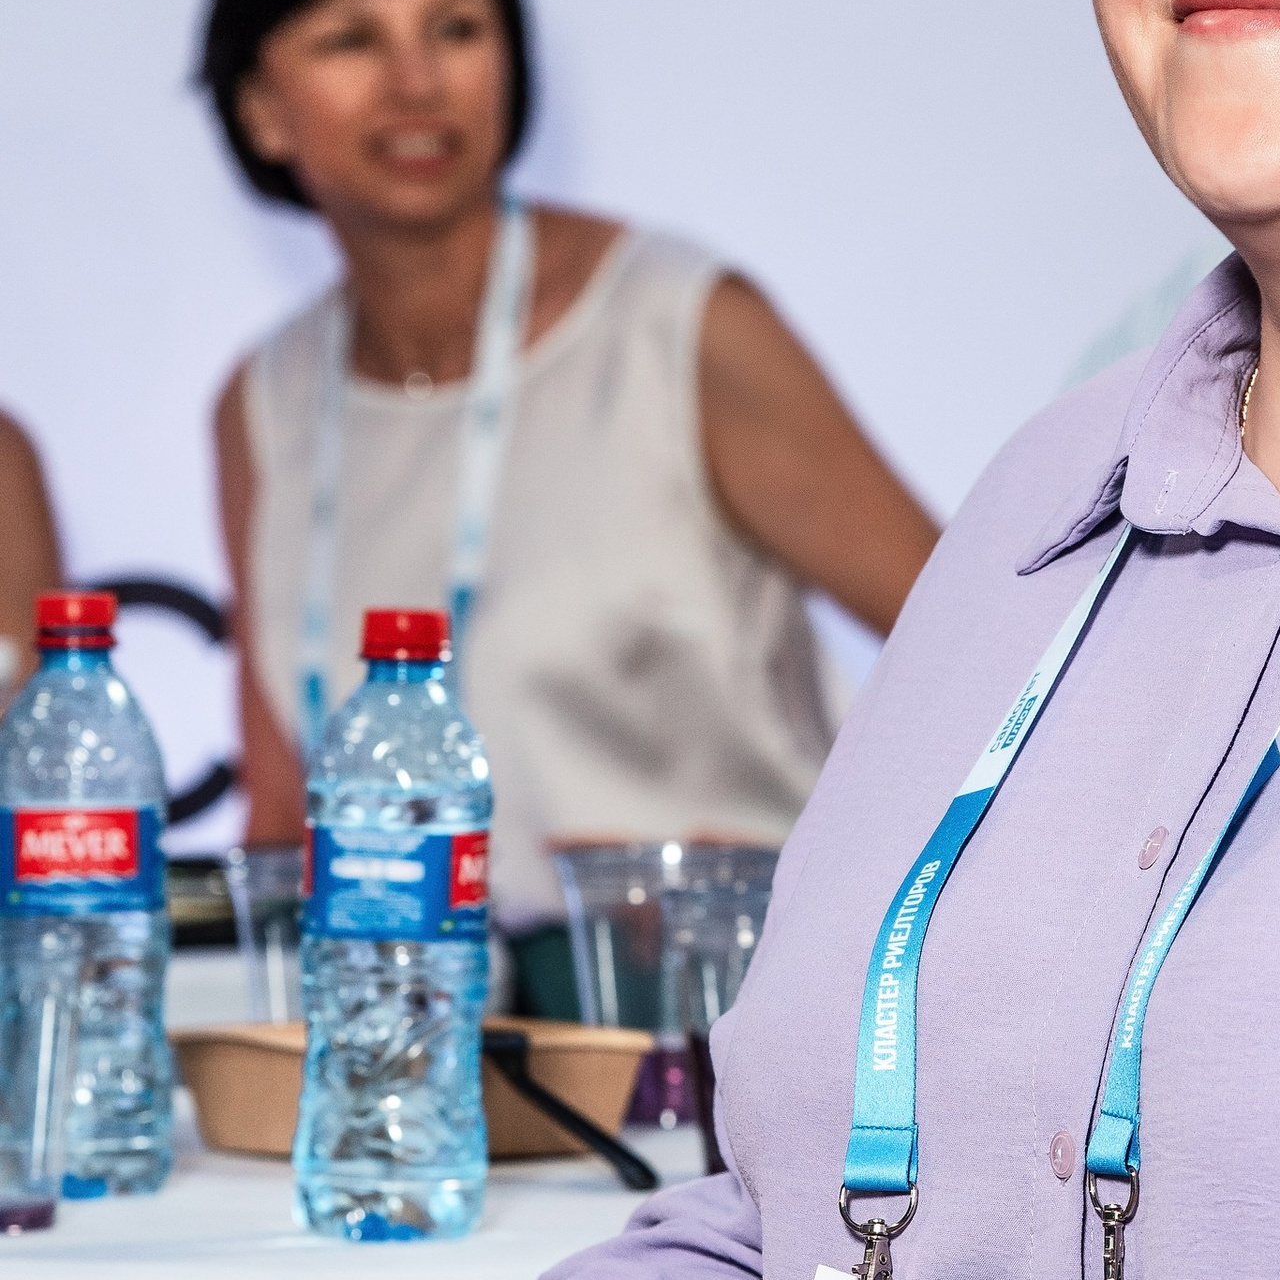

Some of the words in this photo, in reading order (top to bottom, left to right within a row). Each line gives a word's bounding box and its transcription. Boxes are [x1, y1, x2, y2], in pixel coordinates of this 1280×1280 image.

[989, 672, 1040, 753] самолет
[883, 859, 942, 969] РИЕЛТОРОВ
[1120, 951, 1155, 1048] КЛАСТЕР
[1153, 842, 1216, 947] РИЕЛТО
[873, 971, 901, 1071] КЛАСТЕР
